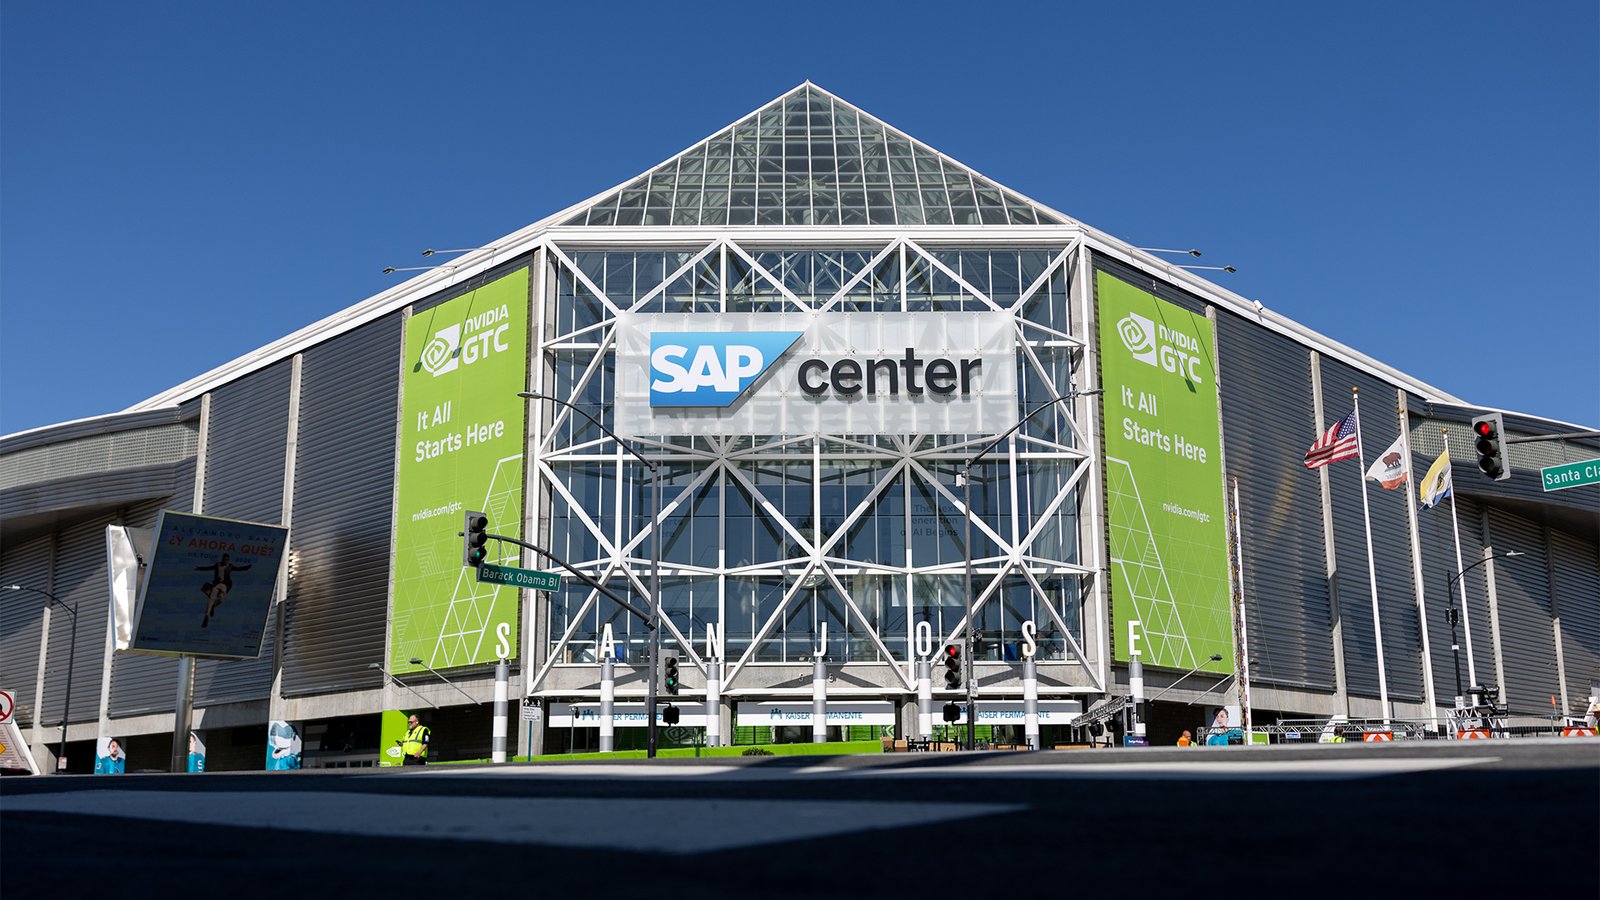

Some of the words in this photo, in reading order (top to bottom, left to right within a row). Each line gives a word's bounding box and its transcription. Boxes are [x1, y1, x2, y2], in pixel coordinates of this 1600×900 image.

[462, 323, 509, 364] GTC
[650, 345, 763, 393] SAP
[798, 348, 982, 395] center
[1160, 345, 1202, 384] GTC
[1121, 384, 1134, 409] It
[1138, 391, 1157, 417] All
[417, 409, 429, 432] It
[431, 401, 451, 426] All
[415, 431, 462, 463] Starts
[466, 418, 505, 447] Here
[1122, 417, 1171, 452] Starts
[1174, 433, 1207, 464] Here
[1545, 469, 1581, 485] Santa
[412, 501, 462, 522] nvidia.com/gtc
[1162, 501, 1210, 523] nvidia.com/gtc
[188, 538, 236, 553] AHORA
[482, 567, 513, 582] Barack
[516, 572, 547, 587] Obama
[785, 712, 810, 720] KAISER
[826, 712, 863, 720] MANENTE
